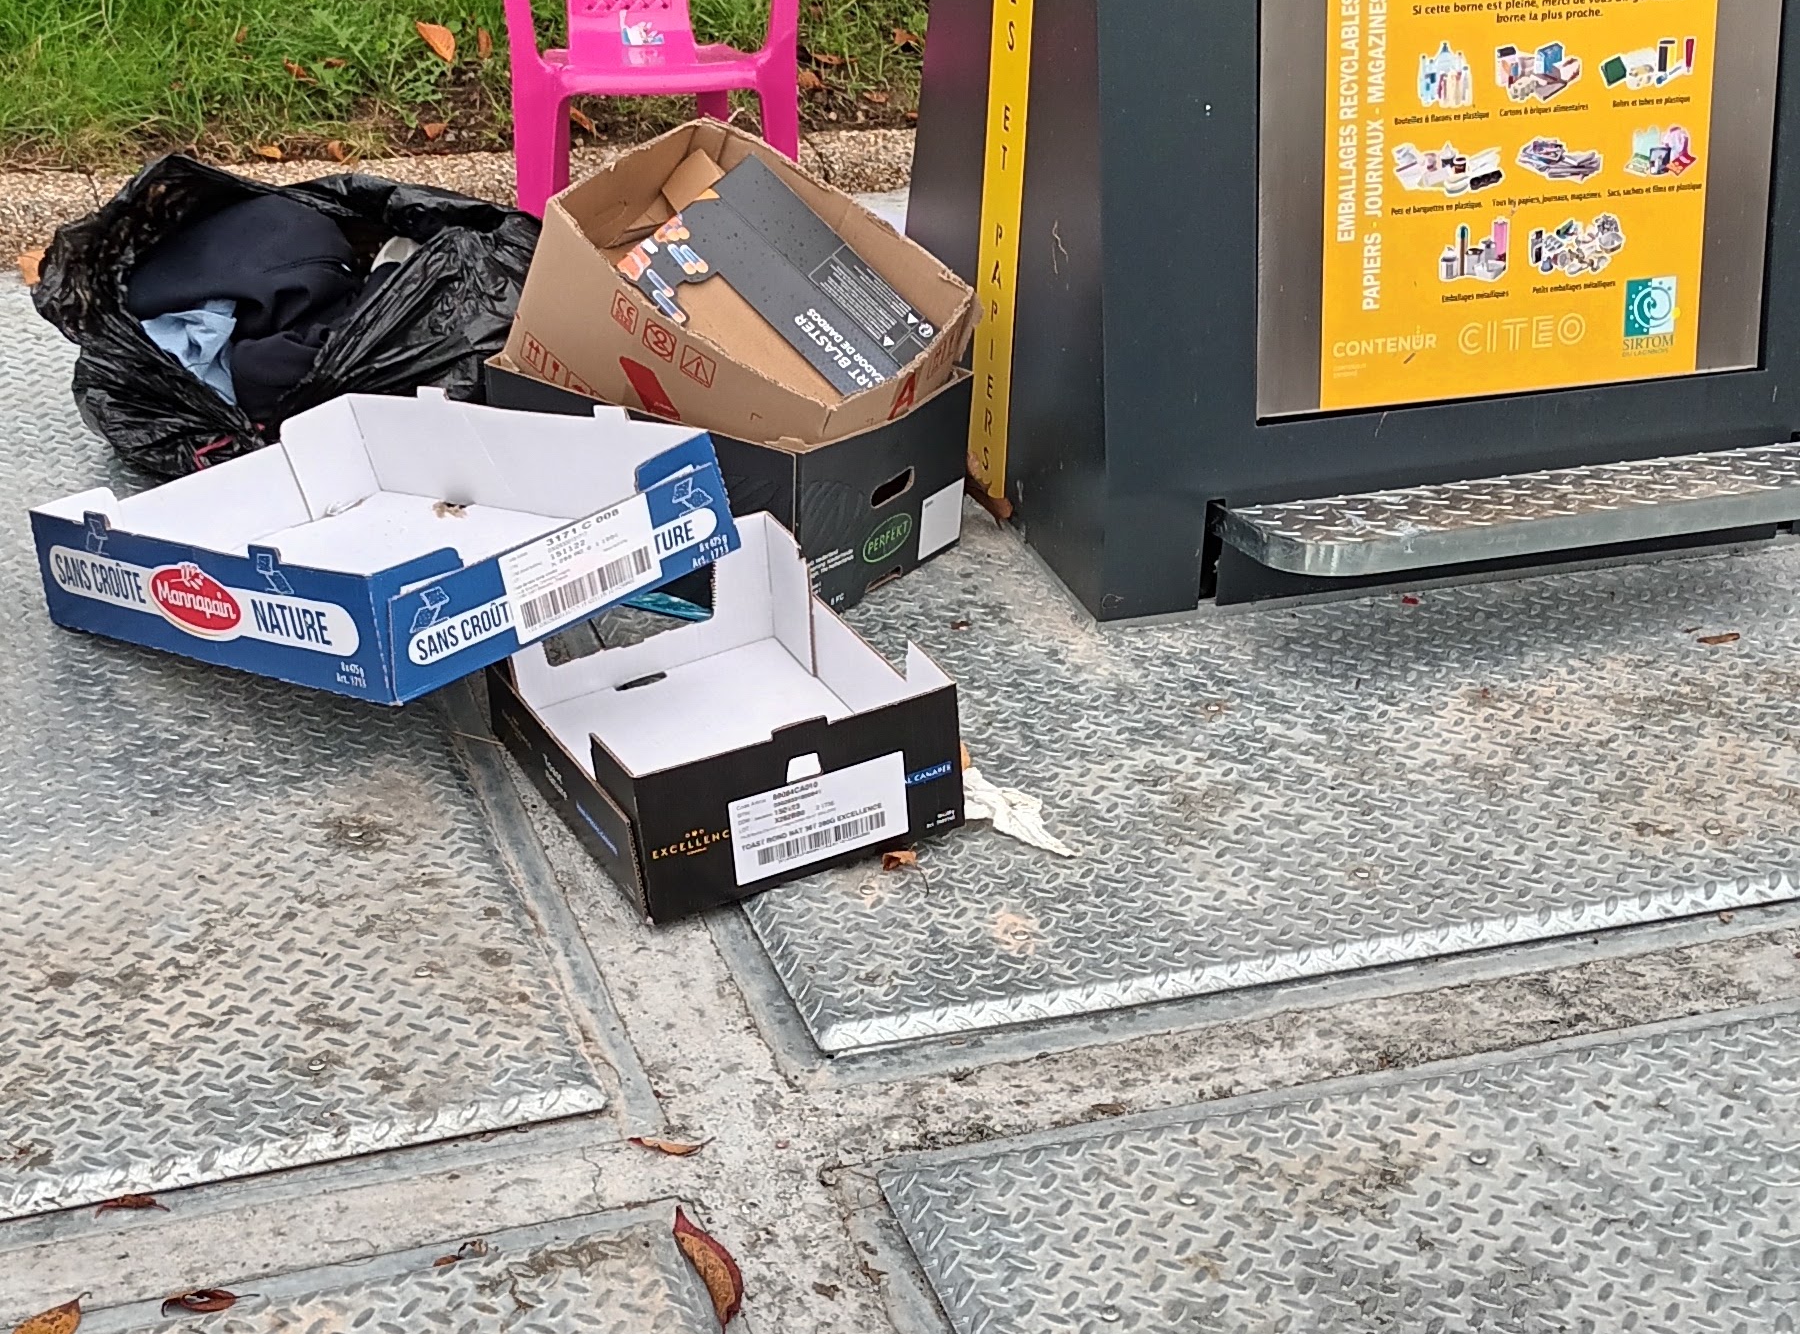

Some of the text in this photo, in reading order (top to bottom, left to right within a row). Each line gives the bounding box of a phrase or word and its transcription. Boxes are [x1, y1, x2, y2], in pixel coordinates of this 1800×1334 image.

[1412, 4, 1422, 15] Si
[1425, 2, 1450, 14] cette
[1454, 1, 1483, 12] borne
[1487, 1, 1502, 10] est
[1496, 7, 1603, 23] borne la plus proche.
[1000, 104, 1011, 171] ET
[1337, 124, 1357, 242] EMBALLAGES
[1364, 119, 1385, 218] JOURNAUX
[1362, 232, 1382, 311] PAPIERS
[794, 313, 851, 369] BLASTER
[807, 308, 885, 383] ZADOR DE DARDOS
[982, 223, 1003, 471] PAPIERS
[1457, 312, 1586, 355] CITEO
[1623, 334, 1674, 351] SIRTOM
[546, 528, 577, 546] 3171
[654, 519, 695, 555] TURE
[868, 520, 909, 555] PERFEKT
[55, 553, 146, 605] SANS CROÛTE
[156, 579, 237, 620] Mannapain
[250, 599, 333, 647] NATURE
[416, 628, 459, 661] SANS
[461, 600, 514, 641] CROÛT
[837, 803, 882, 821] EXCELLENCE
[651, 829, 731, 860] EXCELLENC
